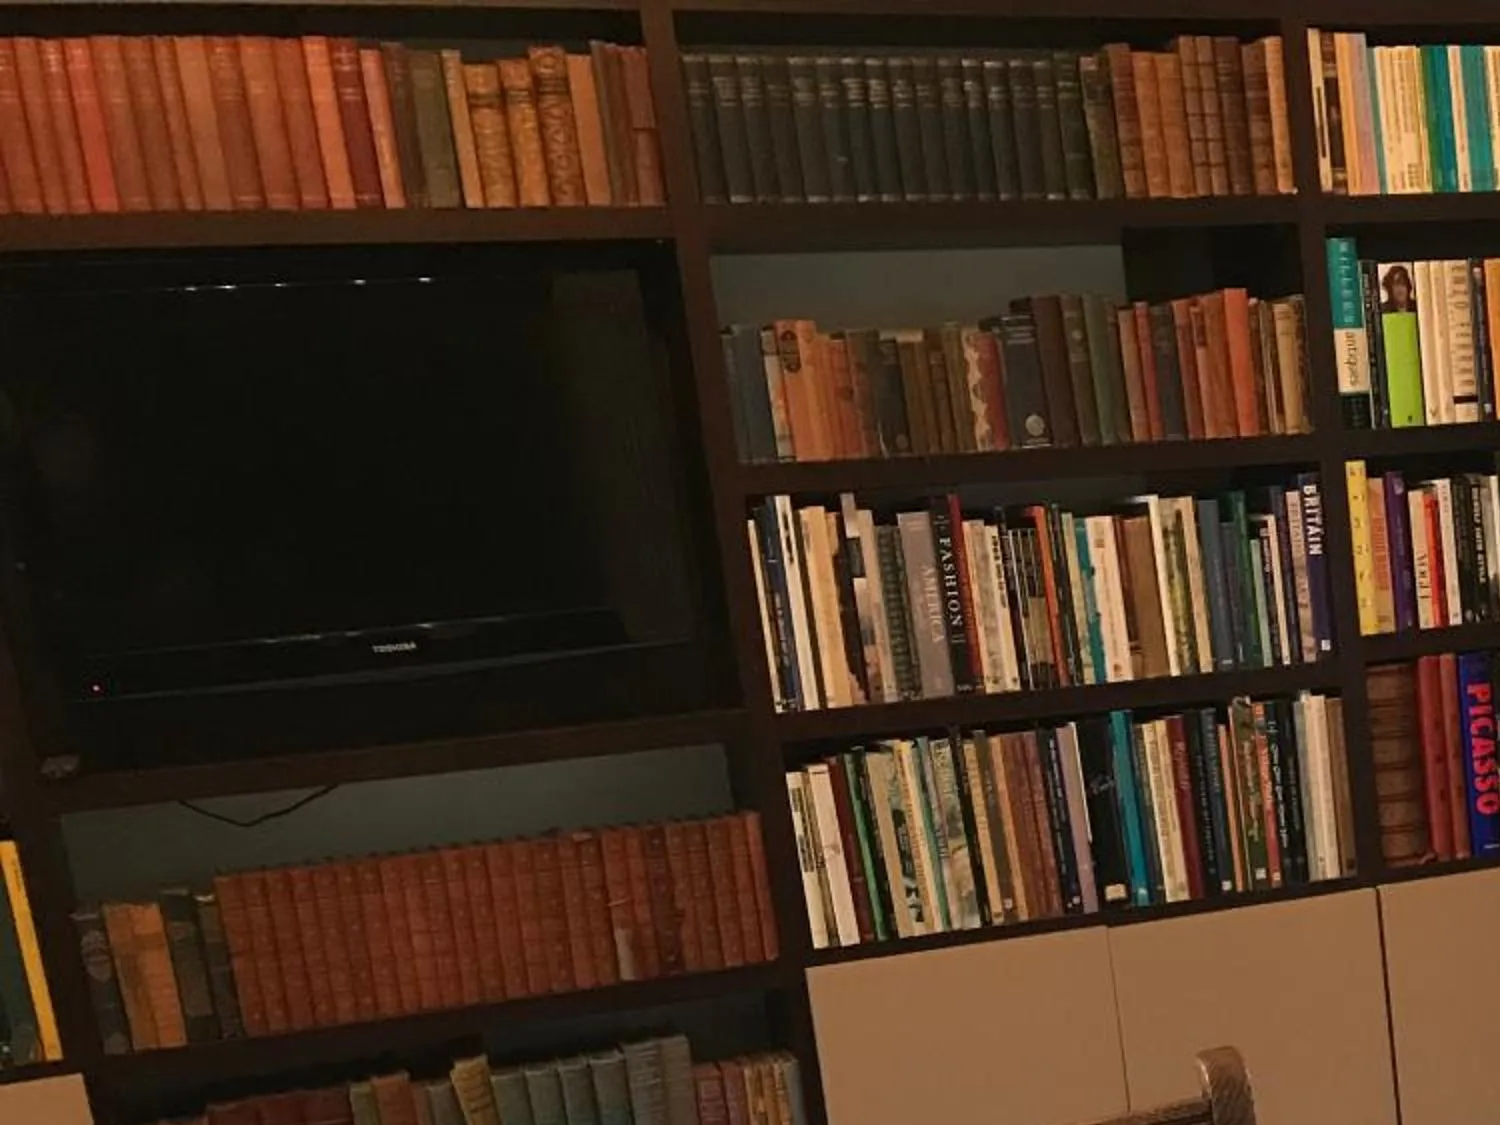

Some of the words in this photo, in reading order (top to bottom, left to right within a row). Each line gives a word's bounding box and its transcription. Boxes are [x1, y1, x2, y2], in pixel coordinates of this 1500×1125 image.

[1303, 484, 1323, 555] BRITAIN
[922, 565, 945, 643] AMERICA
[939, 536, 964, 628] FASHION
[1467, 682, 1500, 816] PICASSO
